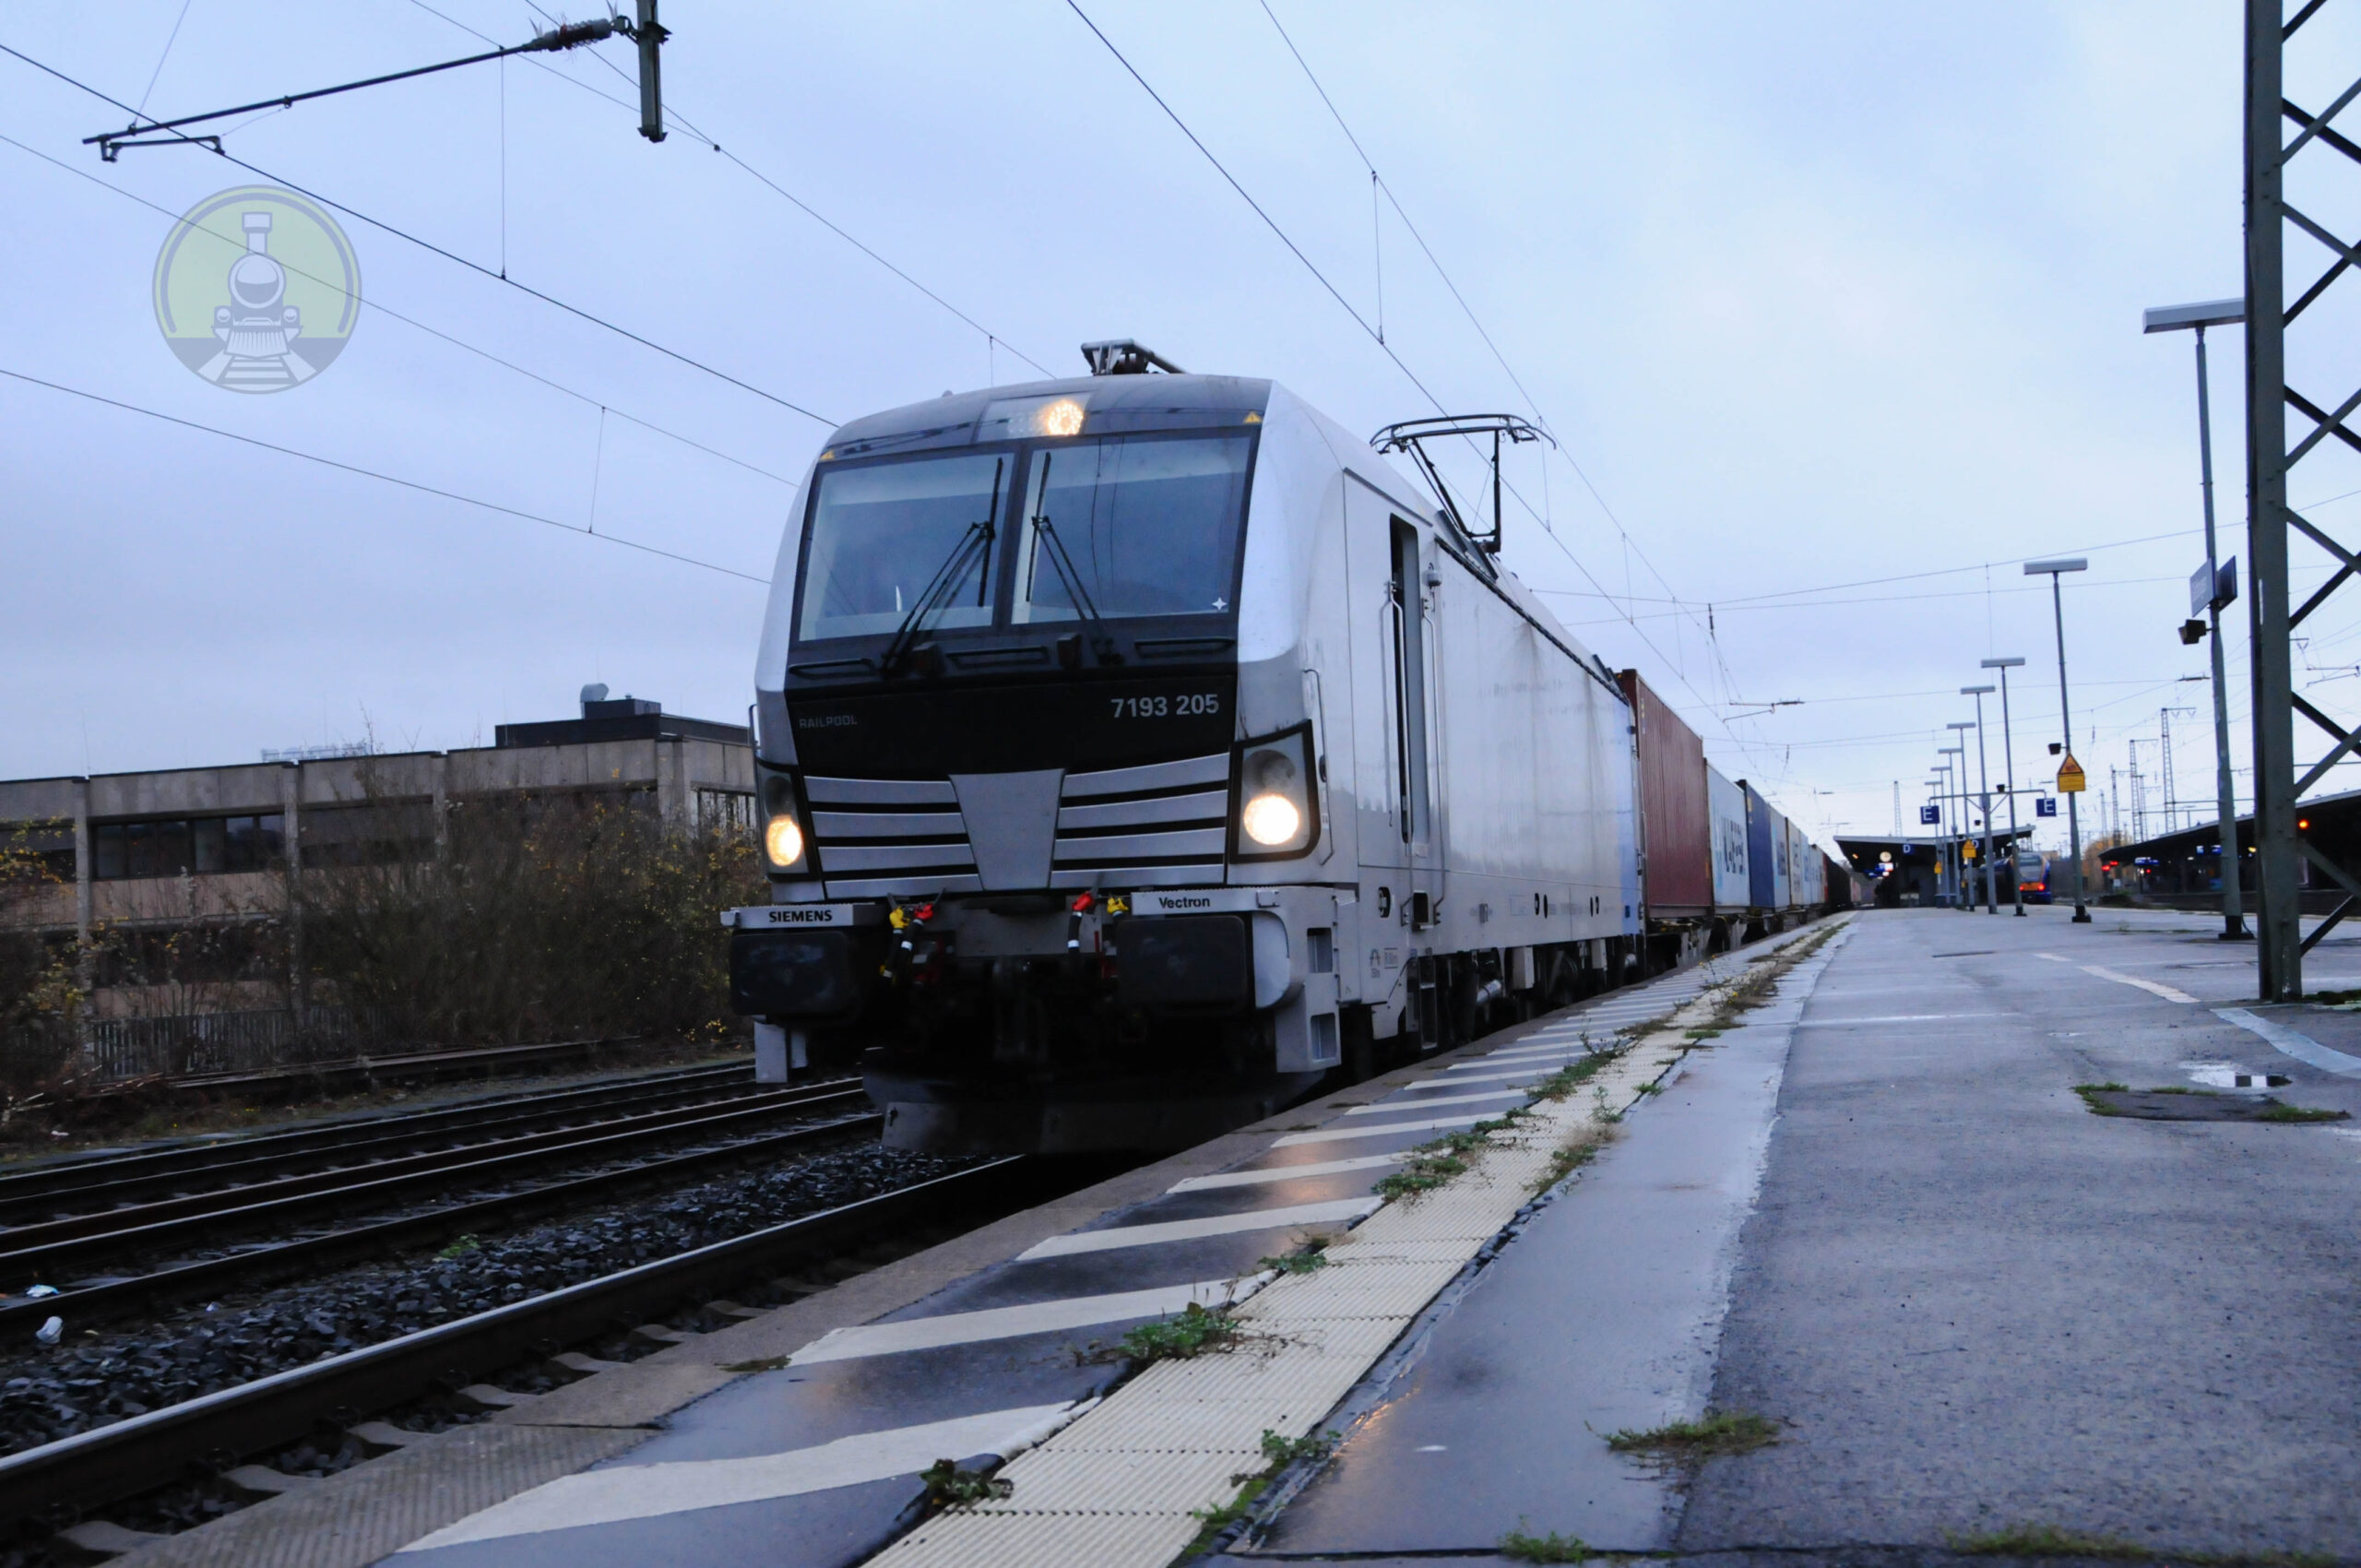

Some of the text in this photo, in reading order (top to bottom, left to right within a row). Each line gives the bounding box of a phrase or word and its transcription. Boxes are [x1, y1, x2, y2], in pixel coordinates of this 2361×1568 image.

[1110, 694, 1219, 718] 7193 205
[799, 715, 859, 729] RAILPOOL
[2044, 798, 2054, 813] E
[1922, 806, 1933, 821] E
[1903, 844, 1911, 854] D
[1158, 897, 1211, 909] Vectron
[768, 909, 833, 922] SIEMENS
